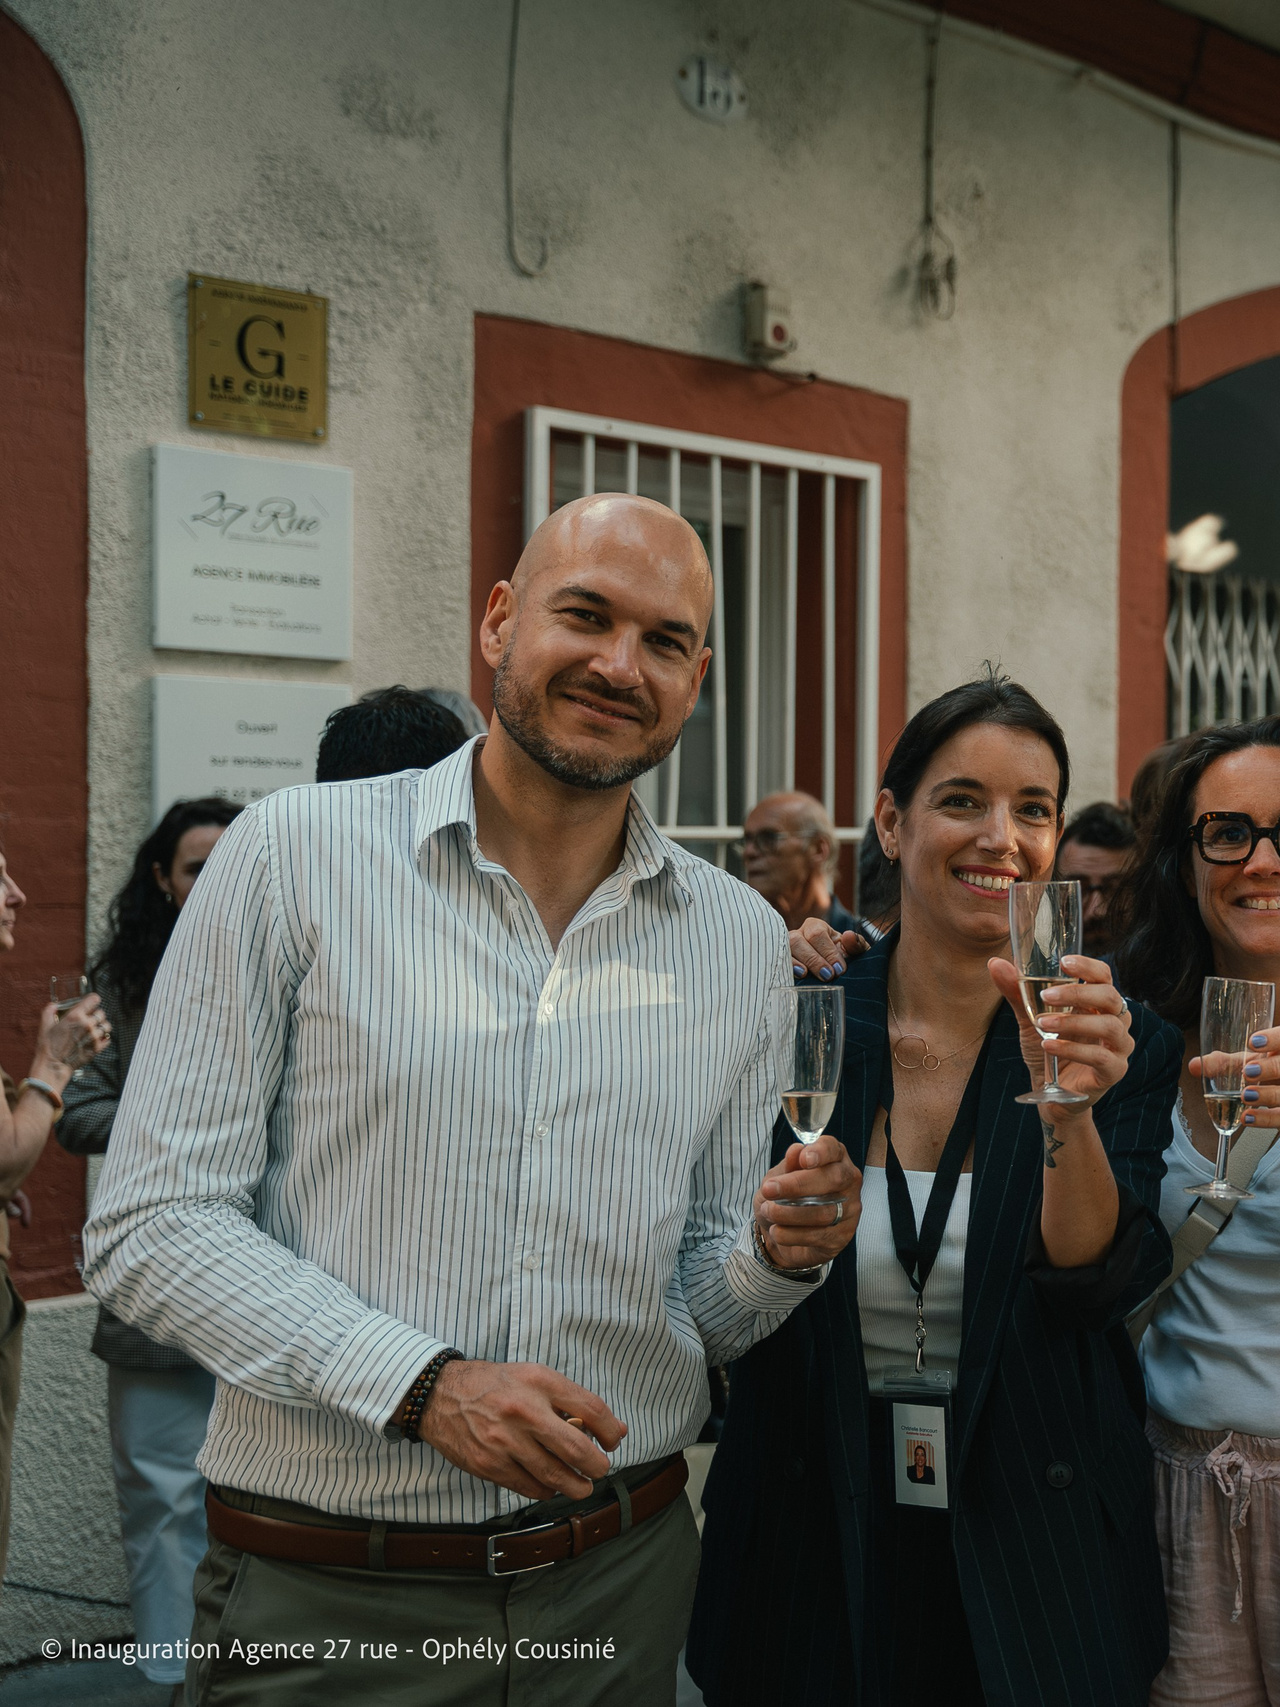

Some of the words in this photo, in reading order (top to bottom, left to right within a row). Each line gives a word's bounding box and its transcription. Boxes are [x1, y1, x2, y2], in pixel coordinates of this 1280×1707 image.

[236, 314, 286, 381] G
[209, 373, 235, 394] LE
[243, 379, 309, 402] GUIDE
[191, 490, 248, 536] 27
[253, 496, 321, 536] Rue
[192, 565, 243, 582] AGENCE
